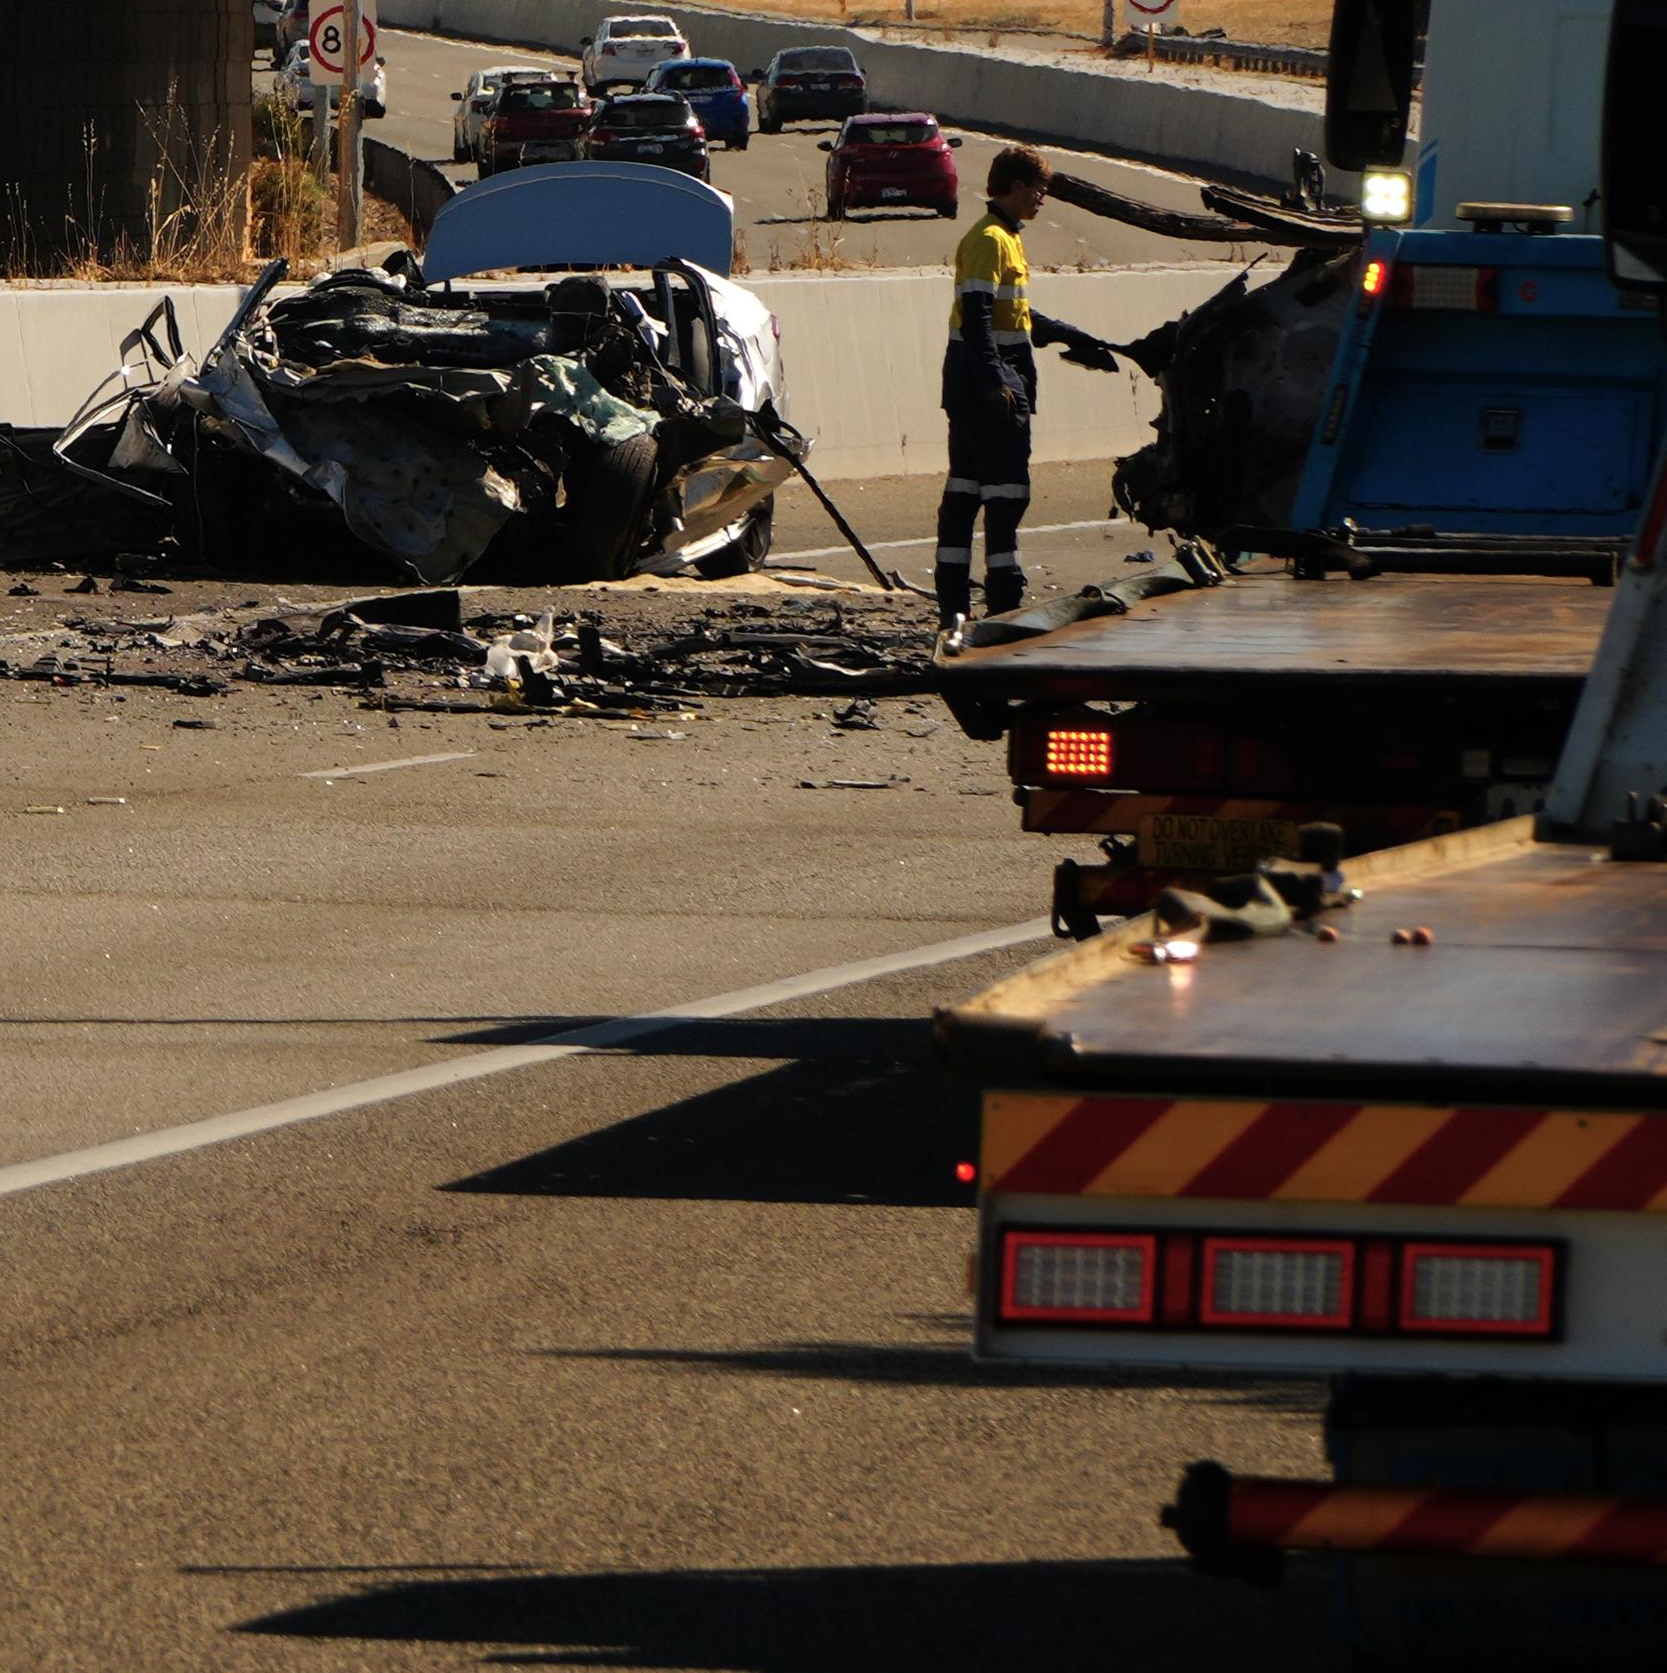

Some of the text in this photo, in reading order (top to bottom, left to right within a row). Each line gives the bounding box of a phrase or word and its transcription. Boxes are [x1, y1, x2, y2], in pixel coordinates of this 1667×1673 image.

[322, 25, 345, 54] 8
[1152, 816, 1173, 840] DO
[1179, 816, 1208, 841] NOT
